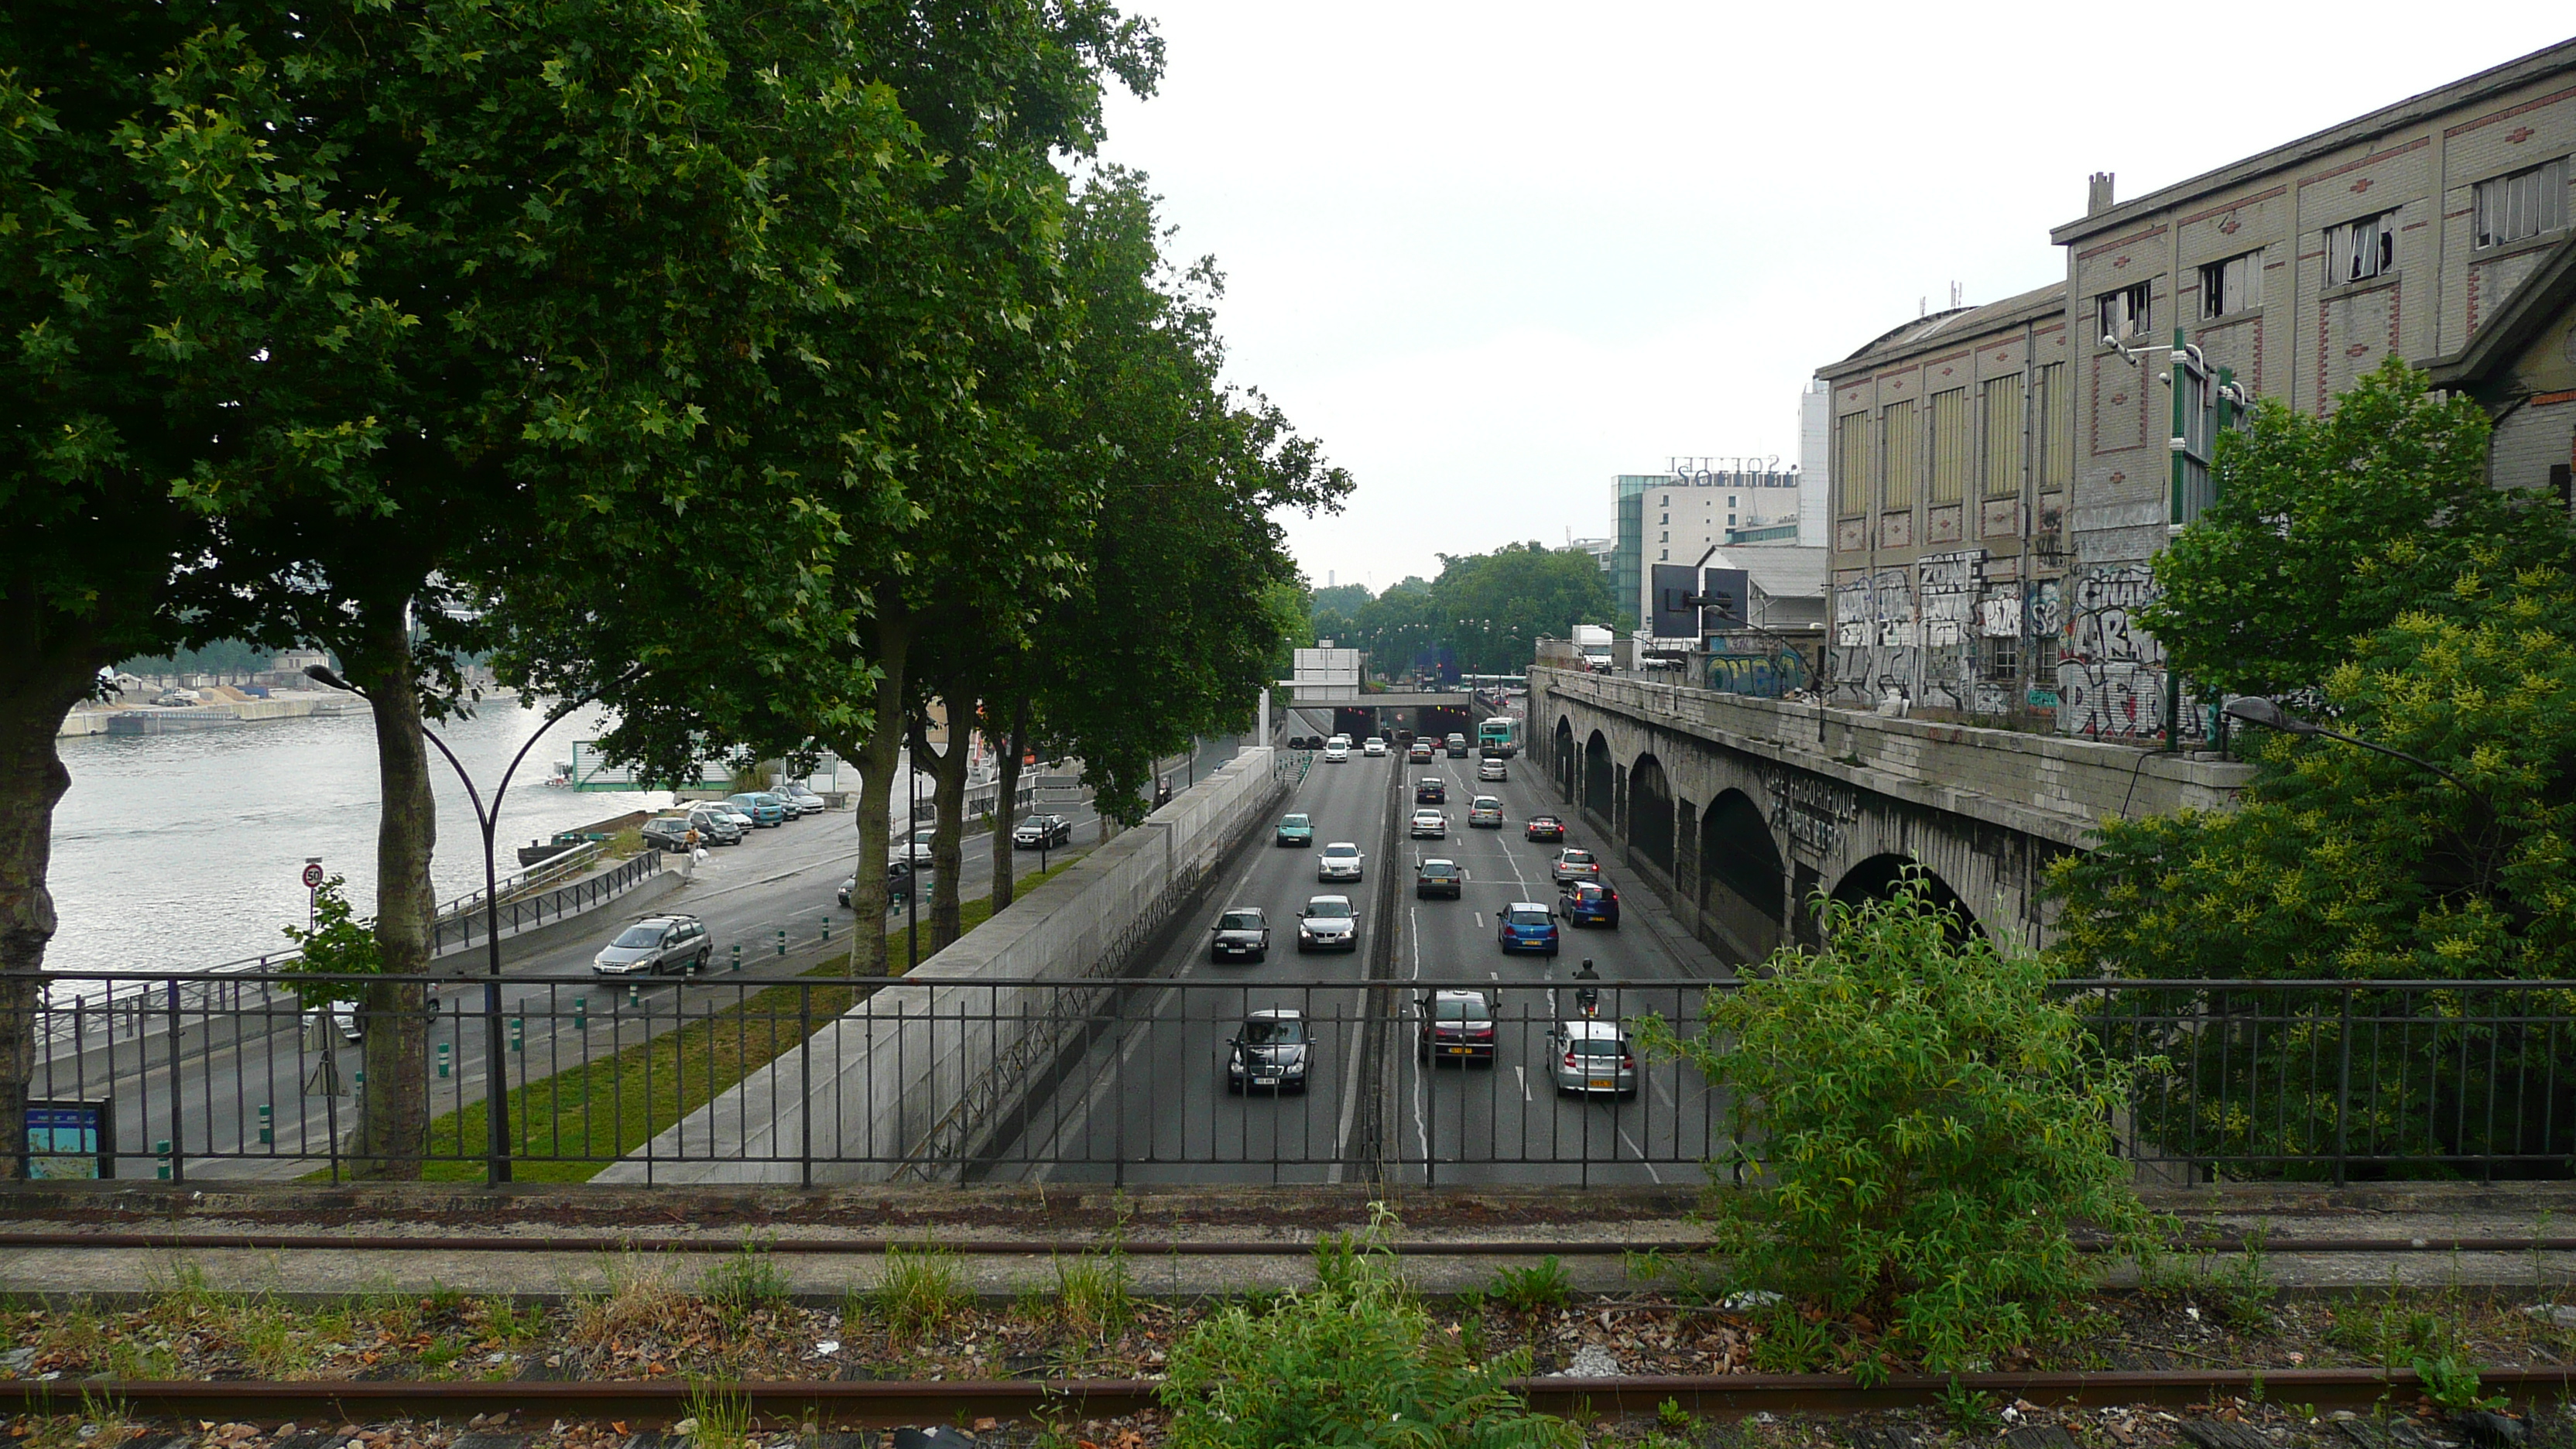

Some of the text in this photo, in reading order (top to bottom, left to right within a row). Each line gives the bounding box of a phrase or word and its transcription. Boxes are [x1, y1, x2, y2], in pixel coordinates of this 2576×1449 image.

[1920, 550, 1989, 594] ZONE
[1766, 766, 1857, 821] GARE FRIGORIFIQUE
[1773, 801, 1845, 859] DE PARIS BERCY
[307, 871, 320, 881] 50
